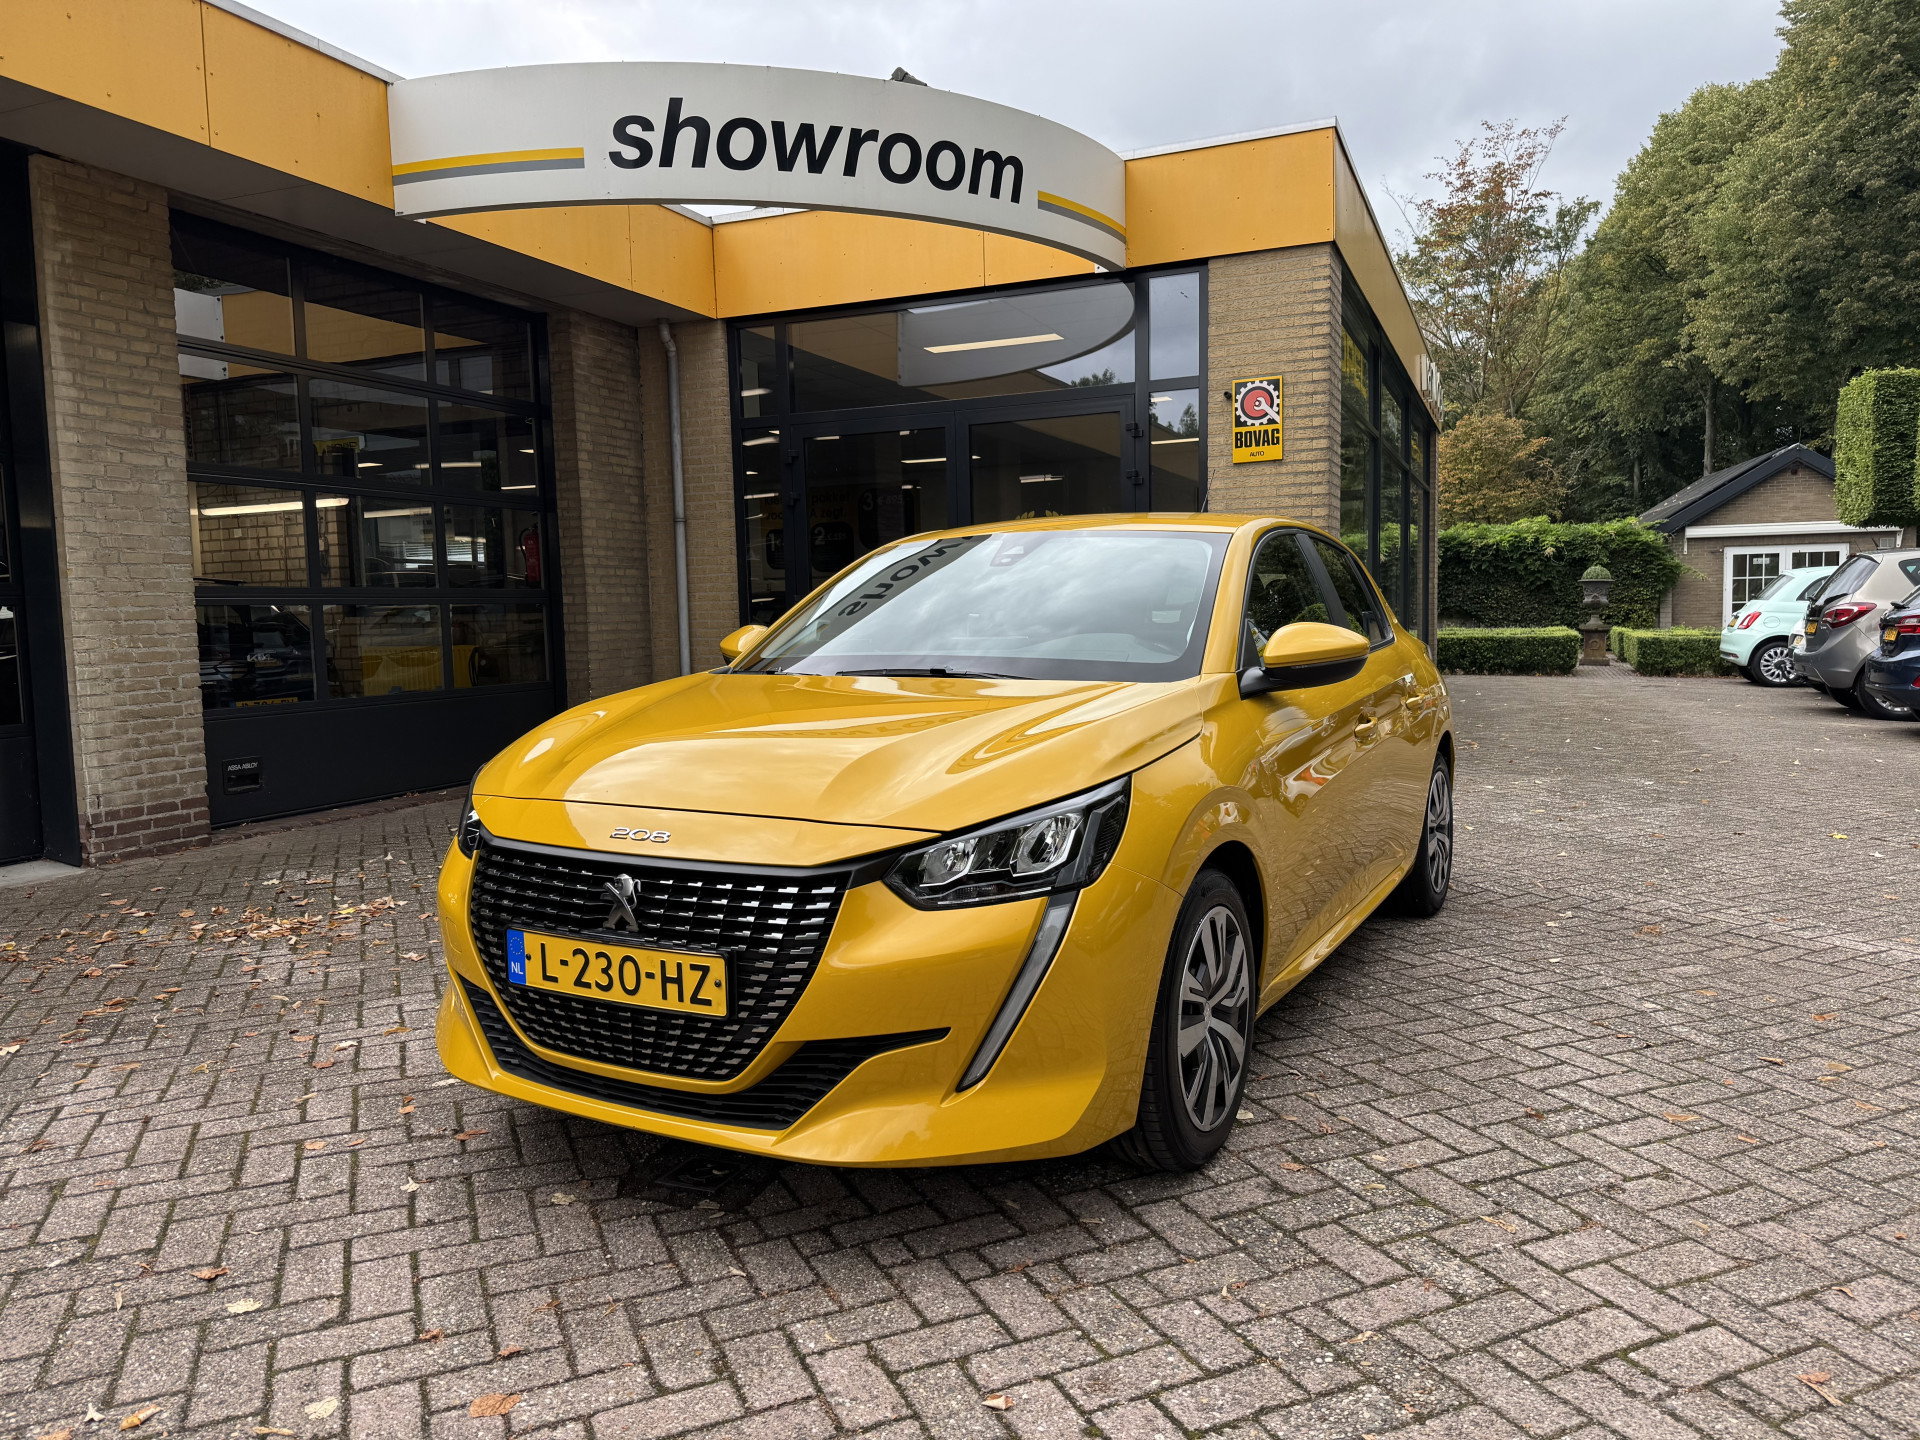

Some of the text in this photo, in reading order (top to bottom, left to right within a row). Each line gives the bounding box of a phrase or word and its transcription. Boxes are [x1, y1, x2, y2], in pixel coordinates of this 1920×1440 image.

[608, 97, 1024, 204] showroom
[1234, 428, 1280, 449] BOVAG
[863, 492, 873, 511] 3
[227, 761, 258, 772] ASSA ABLOY
[609, 827, 671, 843] 208
[511, 961, 524, 975] NL
[540, 943, 713, 1006] L-230-HZ
